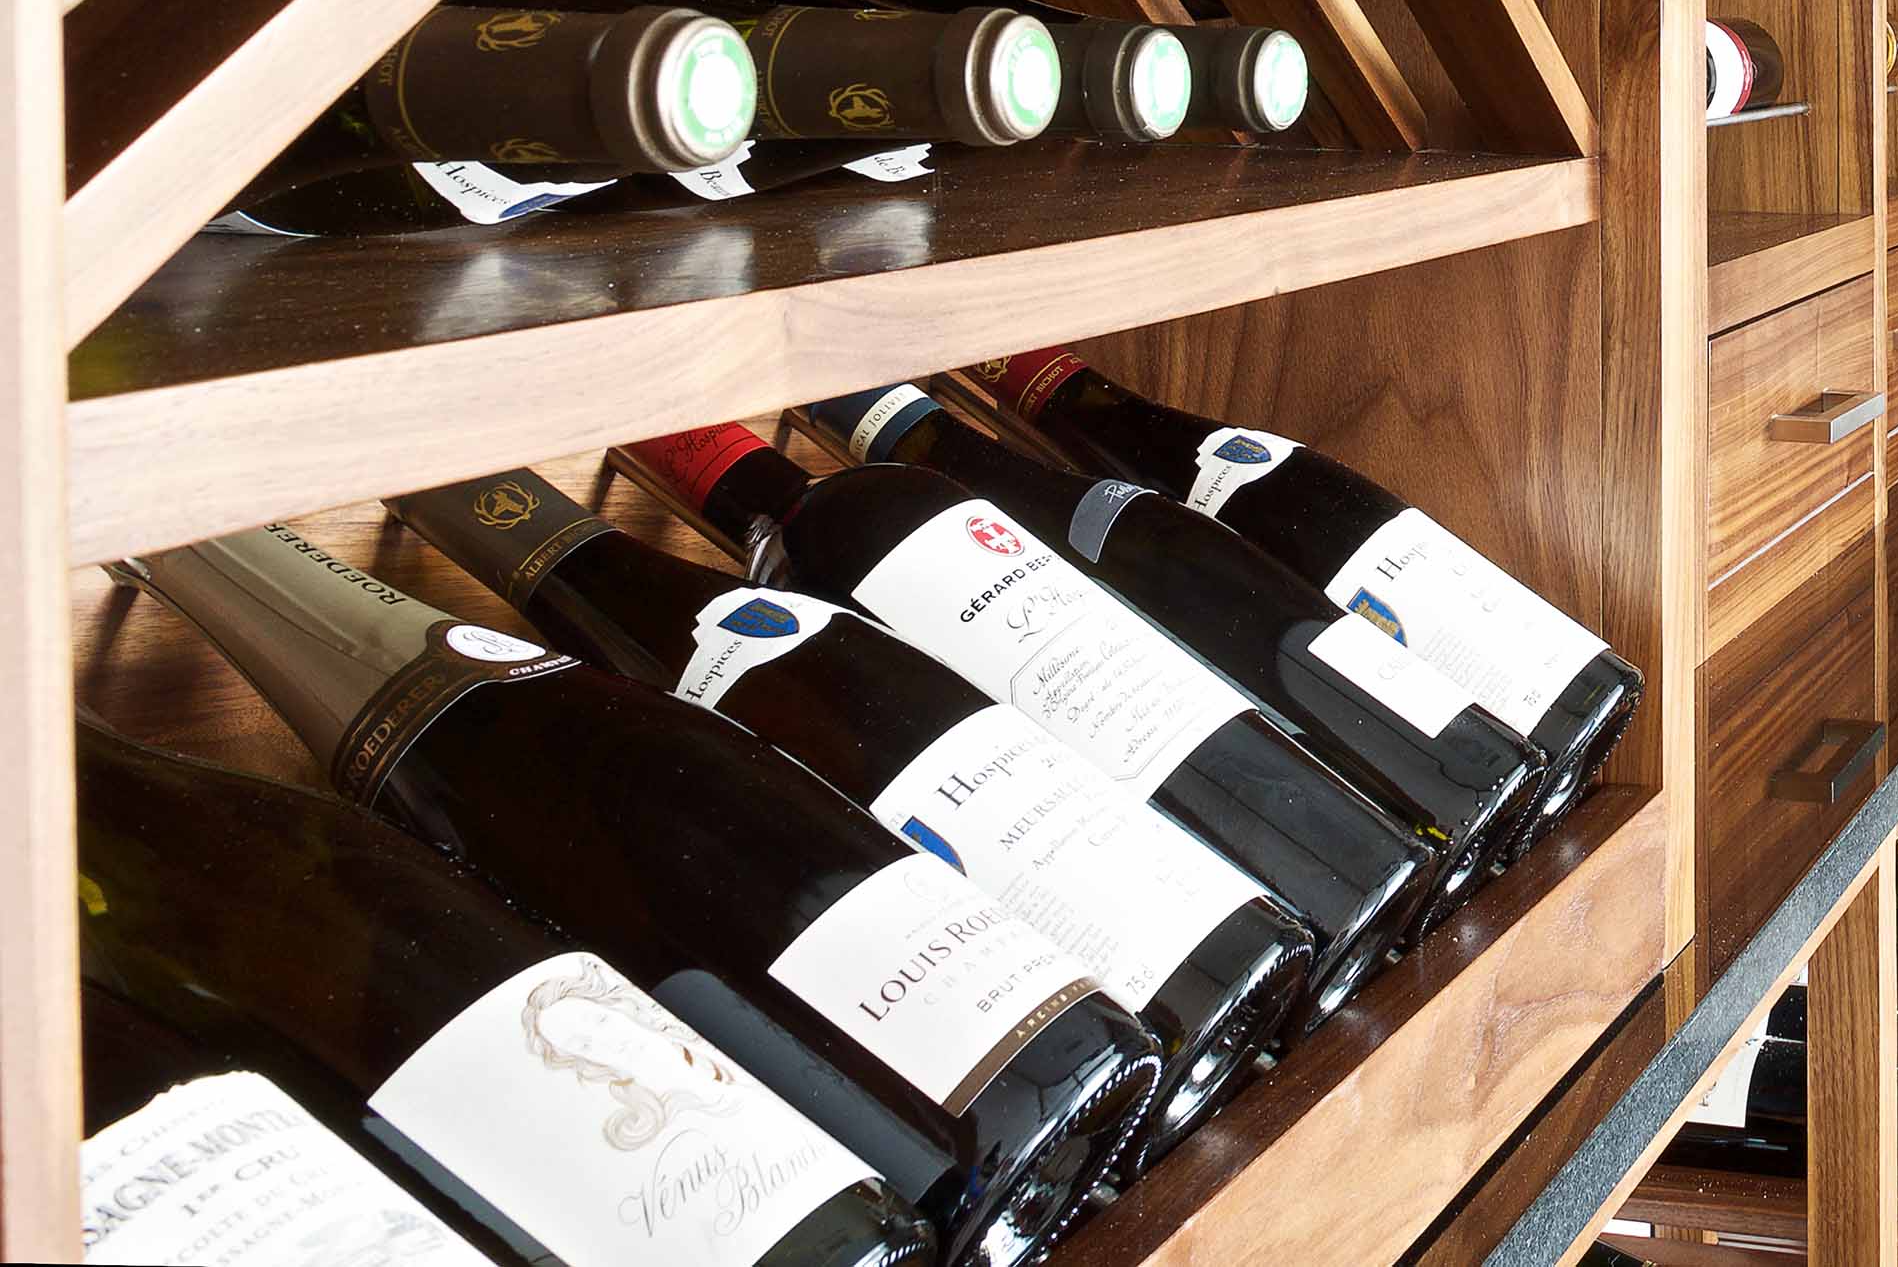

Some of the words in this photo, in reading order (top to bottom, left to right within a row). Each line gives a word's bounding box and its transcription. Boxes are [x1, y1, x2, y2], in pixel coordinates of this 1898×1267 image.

[1036, 364, 1063, 393] BICHOT
[524, 539, 564, 580] ALBERT
[959, 566, 1027, 624] GÉRARD
[857, 938, 952, 1023] LOUIS
[975, 972, 1023, 1014] BRUT
[1126, 978, 1141, 997] 75
[617, 1128, 728, 1238] Vénus
